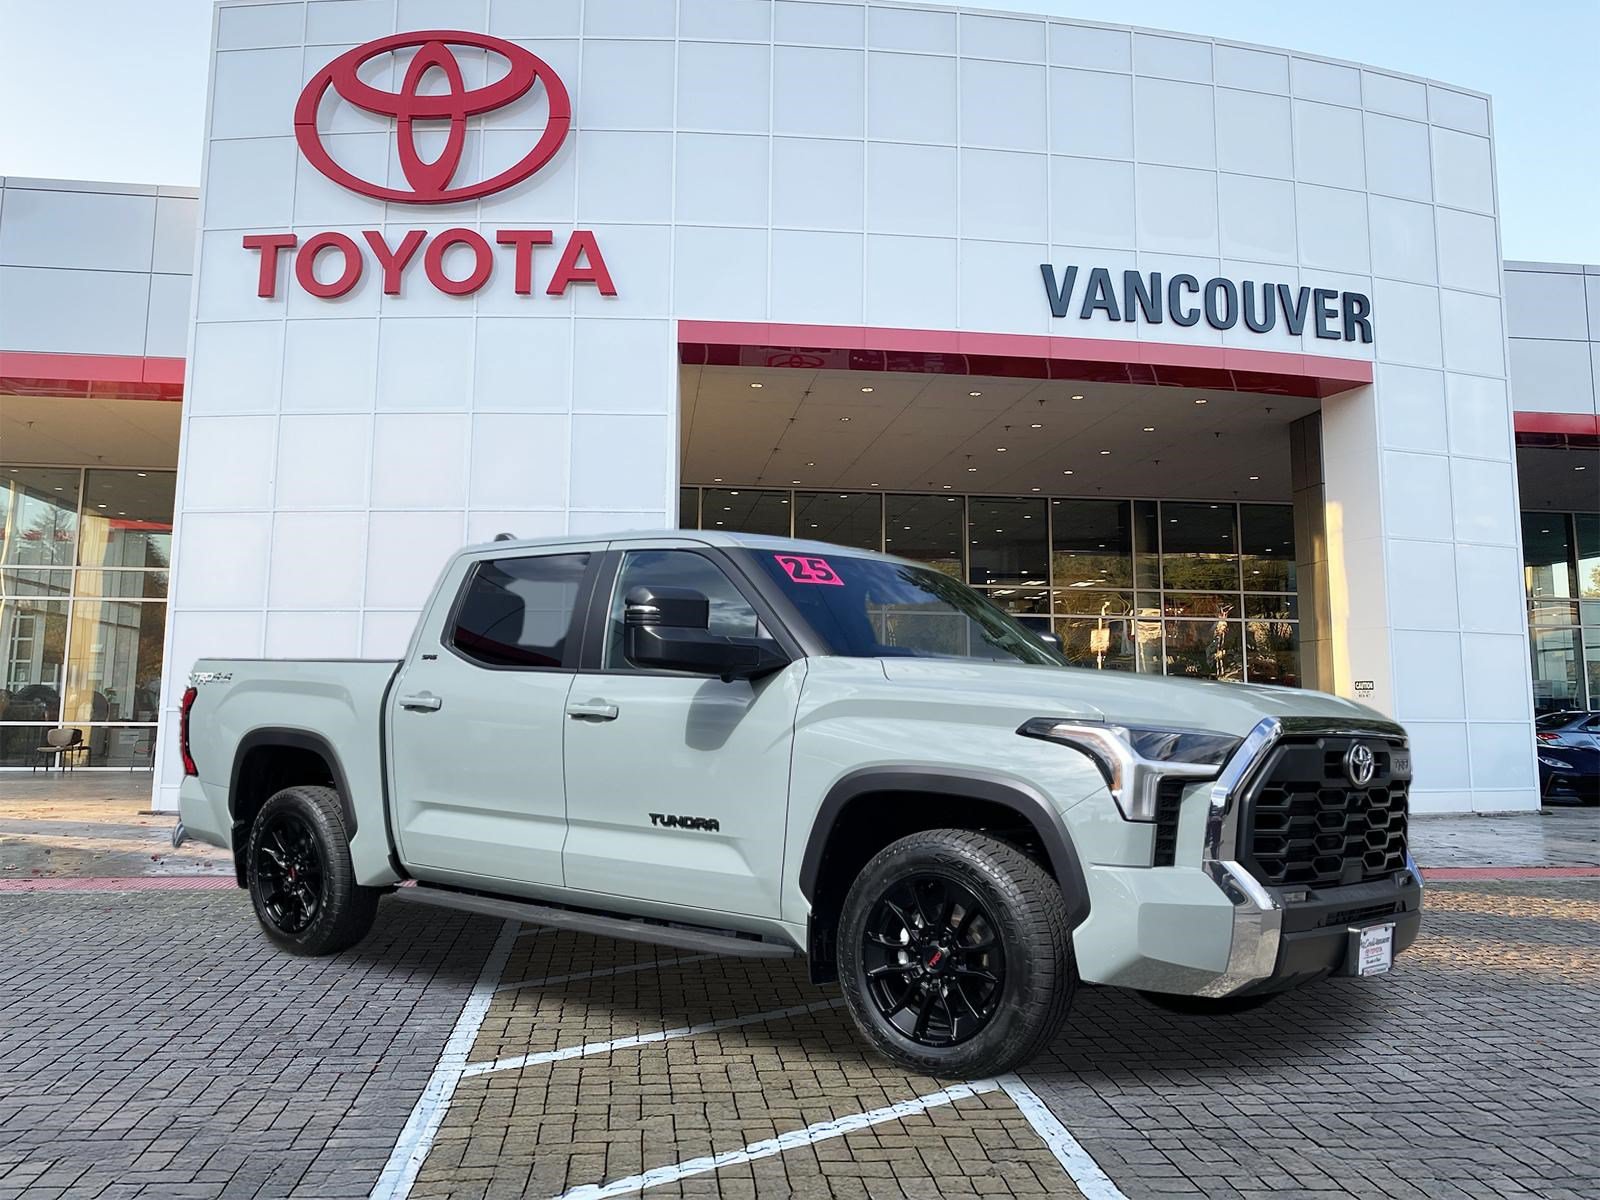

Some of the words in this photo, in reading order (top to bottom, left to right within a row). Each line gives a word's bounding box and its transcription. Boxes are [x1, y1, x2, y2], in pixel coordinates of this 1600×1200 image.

[242, 228, 618, 300] TOYOTA
[1040, 263, 1374, 344] VANCOUVER
[780, 557, 834, 581] 25
[648, 812, 720, 833] TUNDRA
